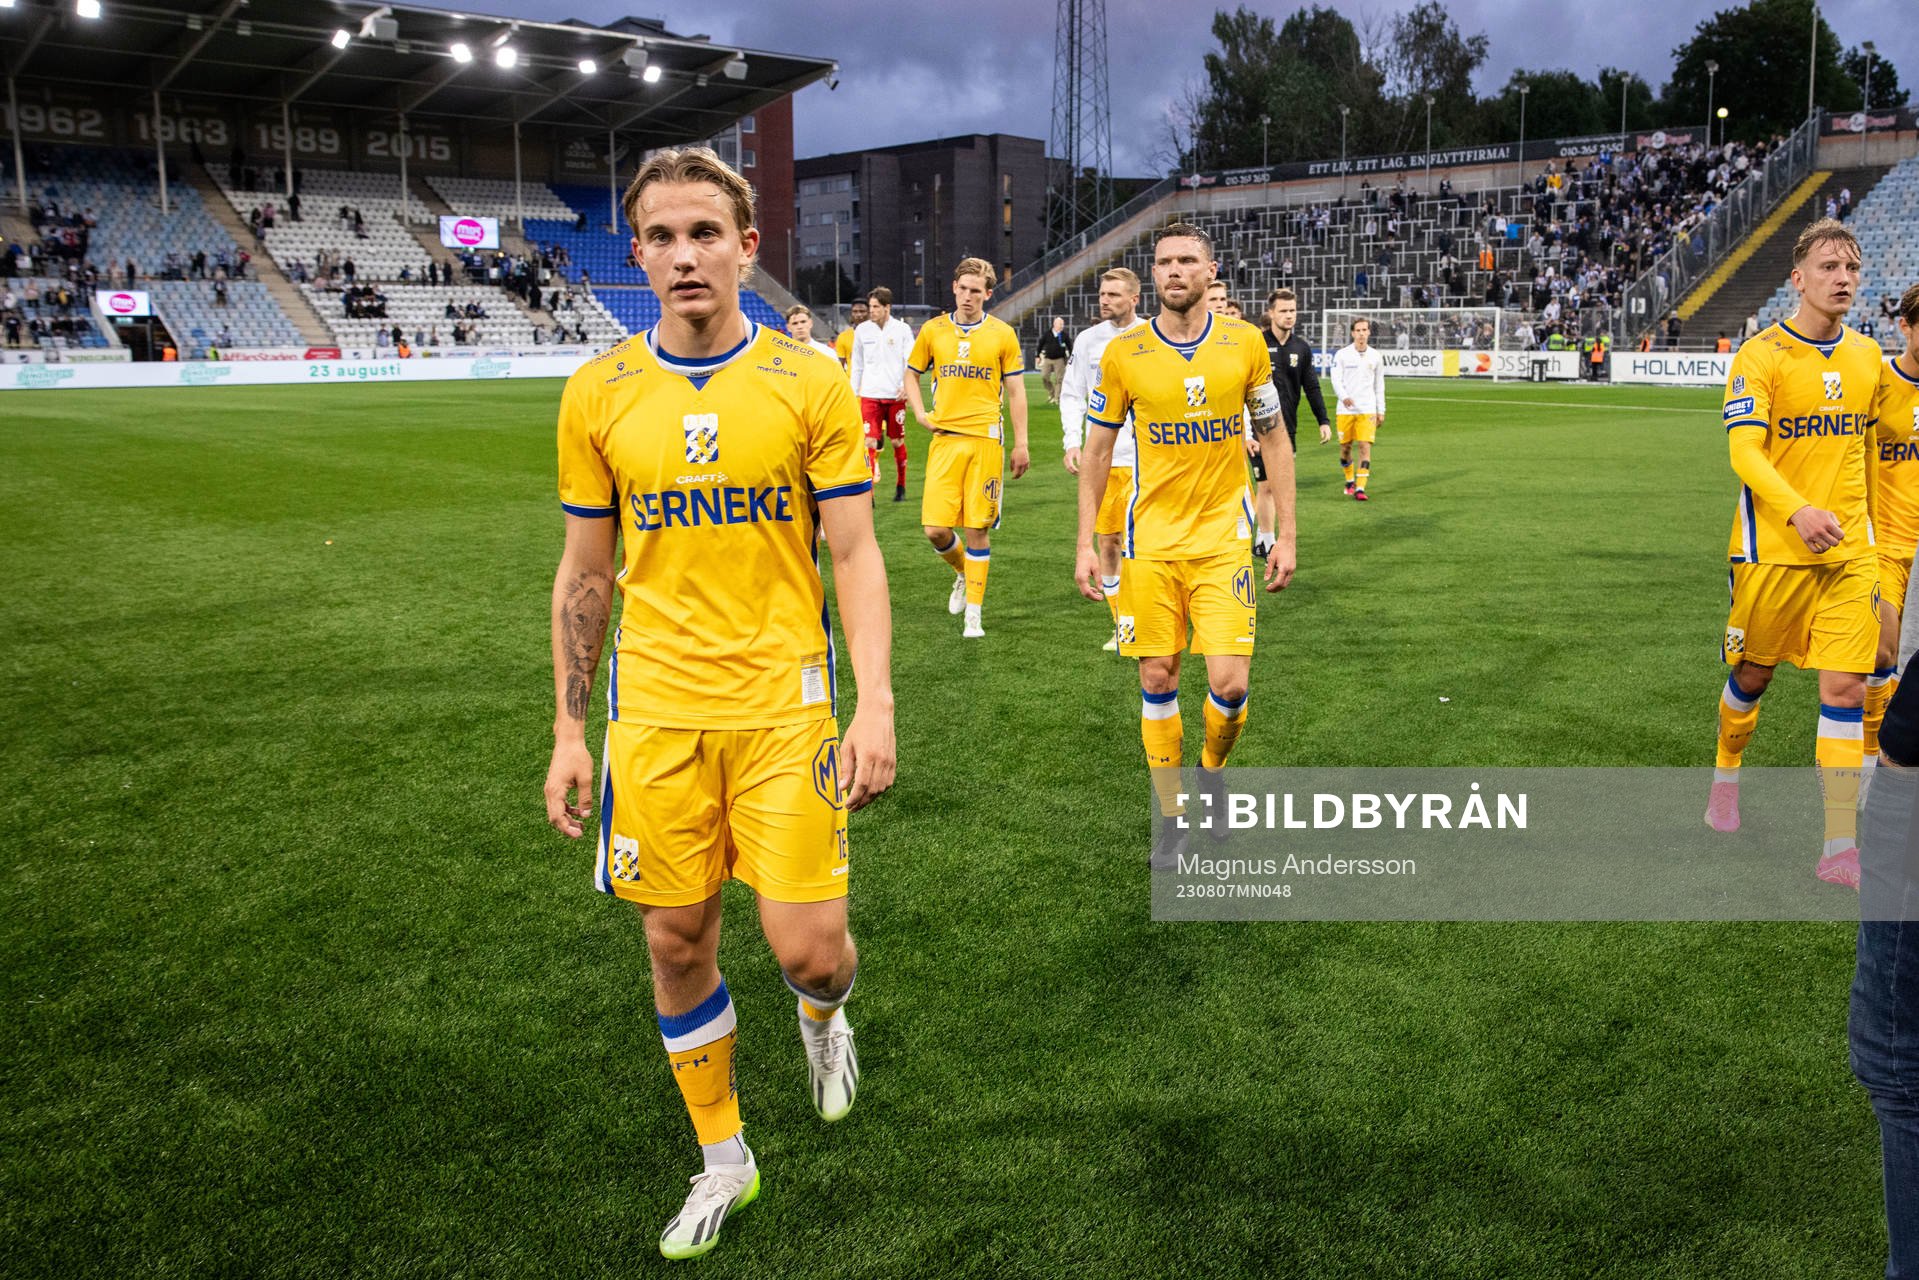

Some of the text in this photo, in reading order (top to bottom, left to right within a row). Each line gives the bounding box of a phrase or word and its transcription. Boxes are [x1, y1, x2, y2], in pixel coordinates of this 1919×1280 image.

[3, 103, 104, 137] 1962
[133, 112, 228, 145] 1963
[254, 123, 341, 154] 1989
[367, 131, 451, 160] 2015
[1308, 163, 1330, 175] ETT
[1356, 159, 1378, 171] ETT
[771, 336, 815, 357] FAMECO
[1387, 352, 1437, 367] weber
[1632, 360, 1726, 377] HOLMEN
[309, 362, 400, 379] 23 augusti
[939, 365, 993, 381] SERNEKE
[1148, 414, 1242, 445] SERNEKE
[1877, 441, 1919, 462] ERN
[676, 474, 717, 485] CRAFT
[631, 485, 794, 532] SERNEKE
